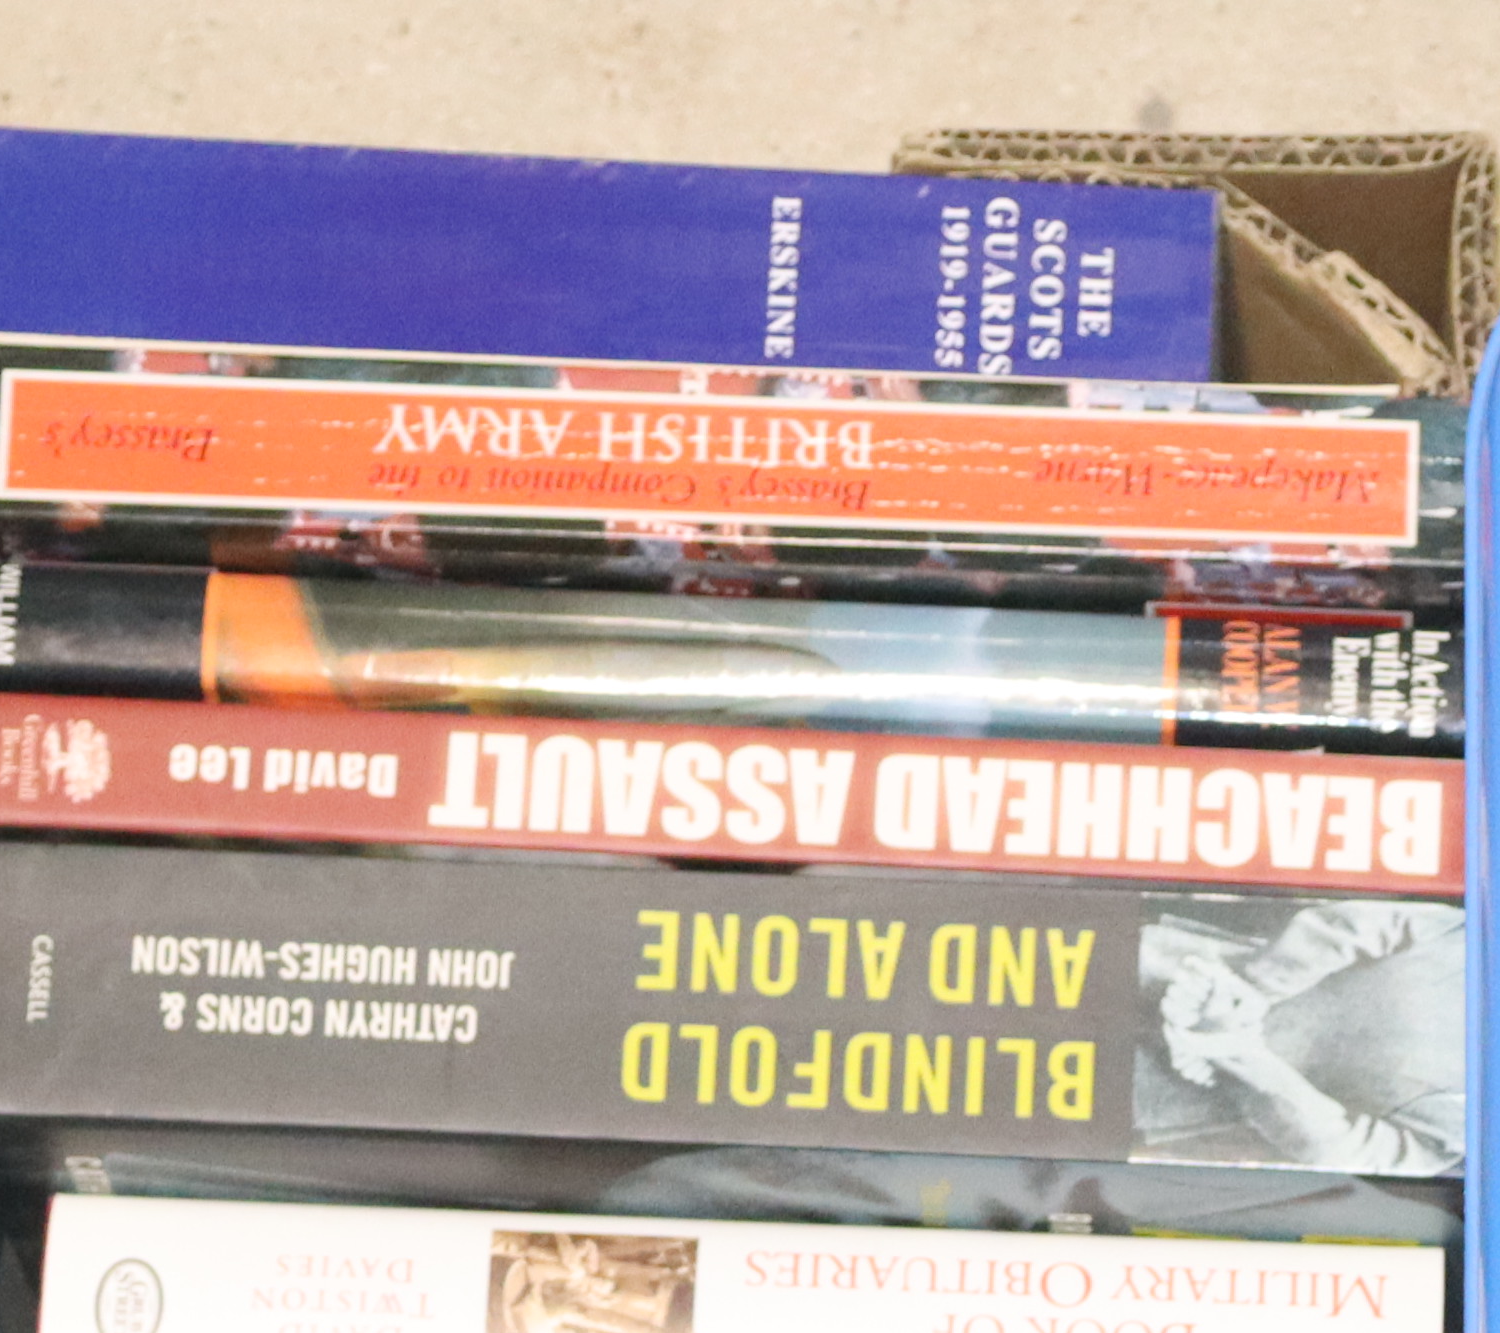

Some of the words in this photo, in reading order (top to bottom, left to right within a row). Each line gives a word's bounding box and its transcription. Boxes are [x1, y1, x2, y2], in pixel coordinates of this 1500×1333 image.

[767, 198, 800, 354] ERSKINE
[935, 208, 969, 366] 1919-1955
[977, 194, 1020, 373] GUARDS
[1030, 220, 1064, 358] SCOTS
[1079, 250, 1112, 333] THE
[170, 745, 250, 789] Lee
[268, 750, 399, 797] David
[424, 728, 856, 841] ASSAULT
[867, 742, 1444, 875] BEACHHEAD
[28, 936, 52, 1020] CASSELL
[132, 936, 416, 984] HUGHES-WILSON
[429, 950, 513, 987] JOHN
[637, 911, 904, 999] ALONE
[930, 925, 1094, 1007] AND
[161, 993, 185, 1029] &
[198, 995, 311, 1034] CORNS
[325, 1000, 477, 1042] CATHRYN
[622, 1023, 1094, 1119] BLINDFOLD
